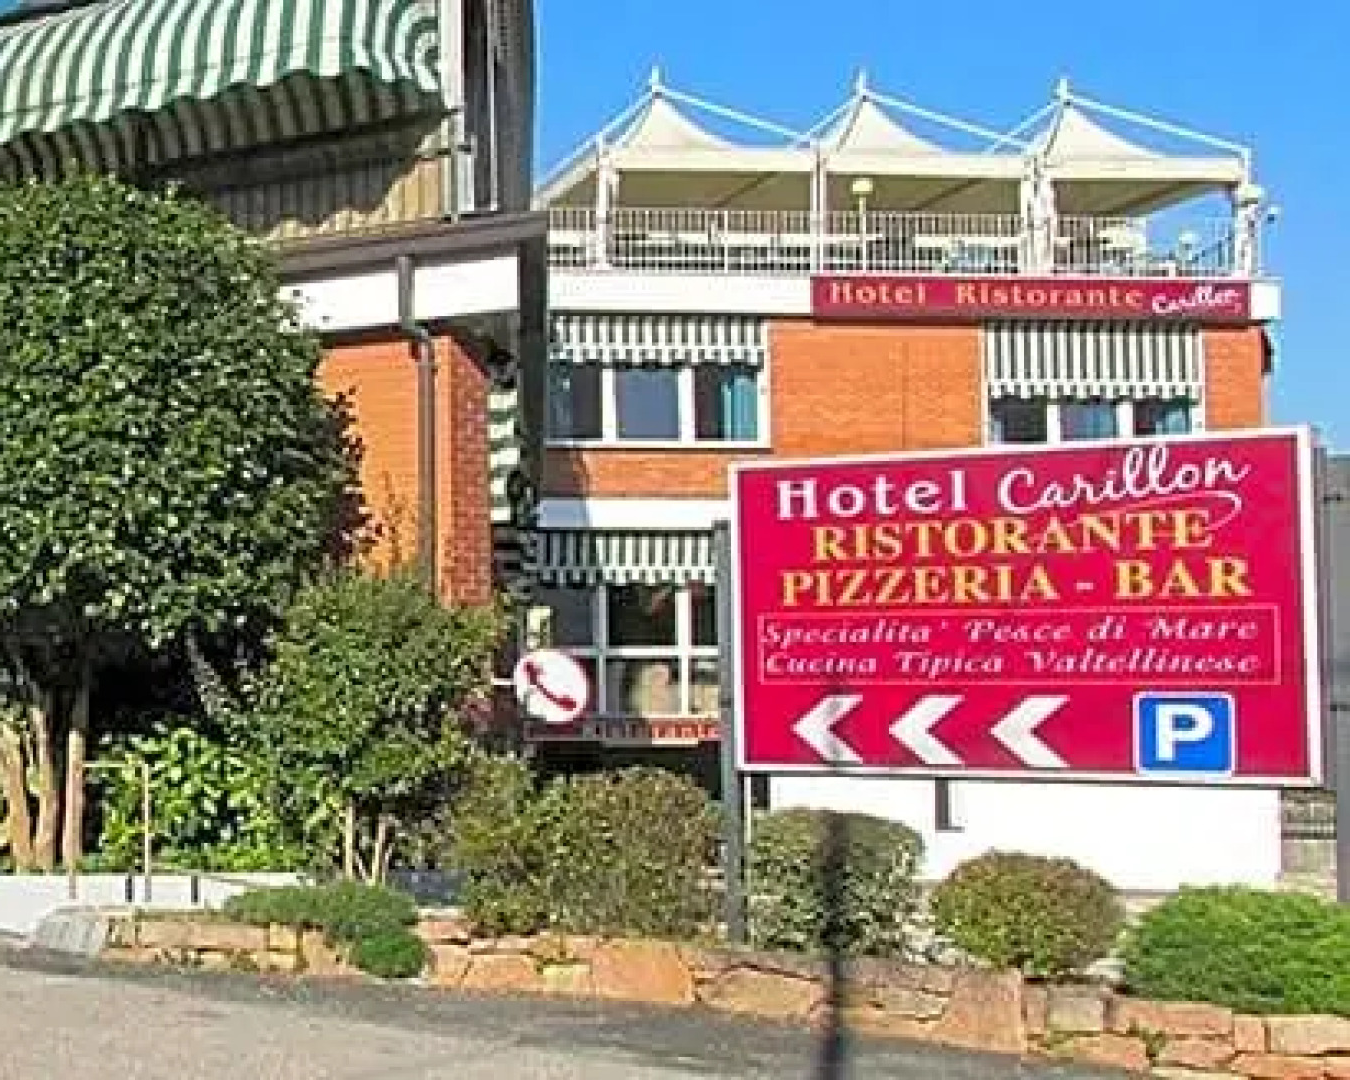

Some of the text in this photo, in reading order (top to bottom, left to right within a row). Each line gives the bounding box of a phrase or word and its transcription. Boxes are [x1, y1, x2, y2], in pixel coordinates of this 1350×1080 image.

[830, 282, 927, 304] Hotel
[957, 283, 1145, 307] Ristorante
[776, 446, 1252, 521] Hotel Carillon
[811, 509, 1214, 562] RISTORANTE
[780, 562, 1061, 608] PIZZERIA
[1112, 555, 1256, 600] BAR
[963, 618, 1071, 643] Pesce
[1086, 614, 1127, 640] di
[1146, 617, 1259, 641] Mare
[765, 647, 1261, 679] Cucina Tipica Valtellinese
[1154, 704, 1214, 762] P
